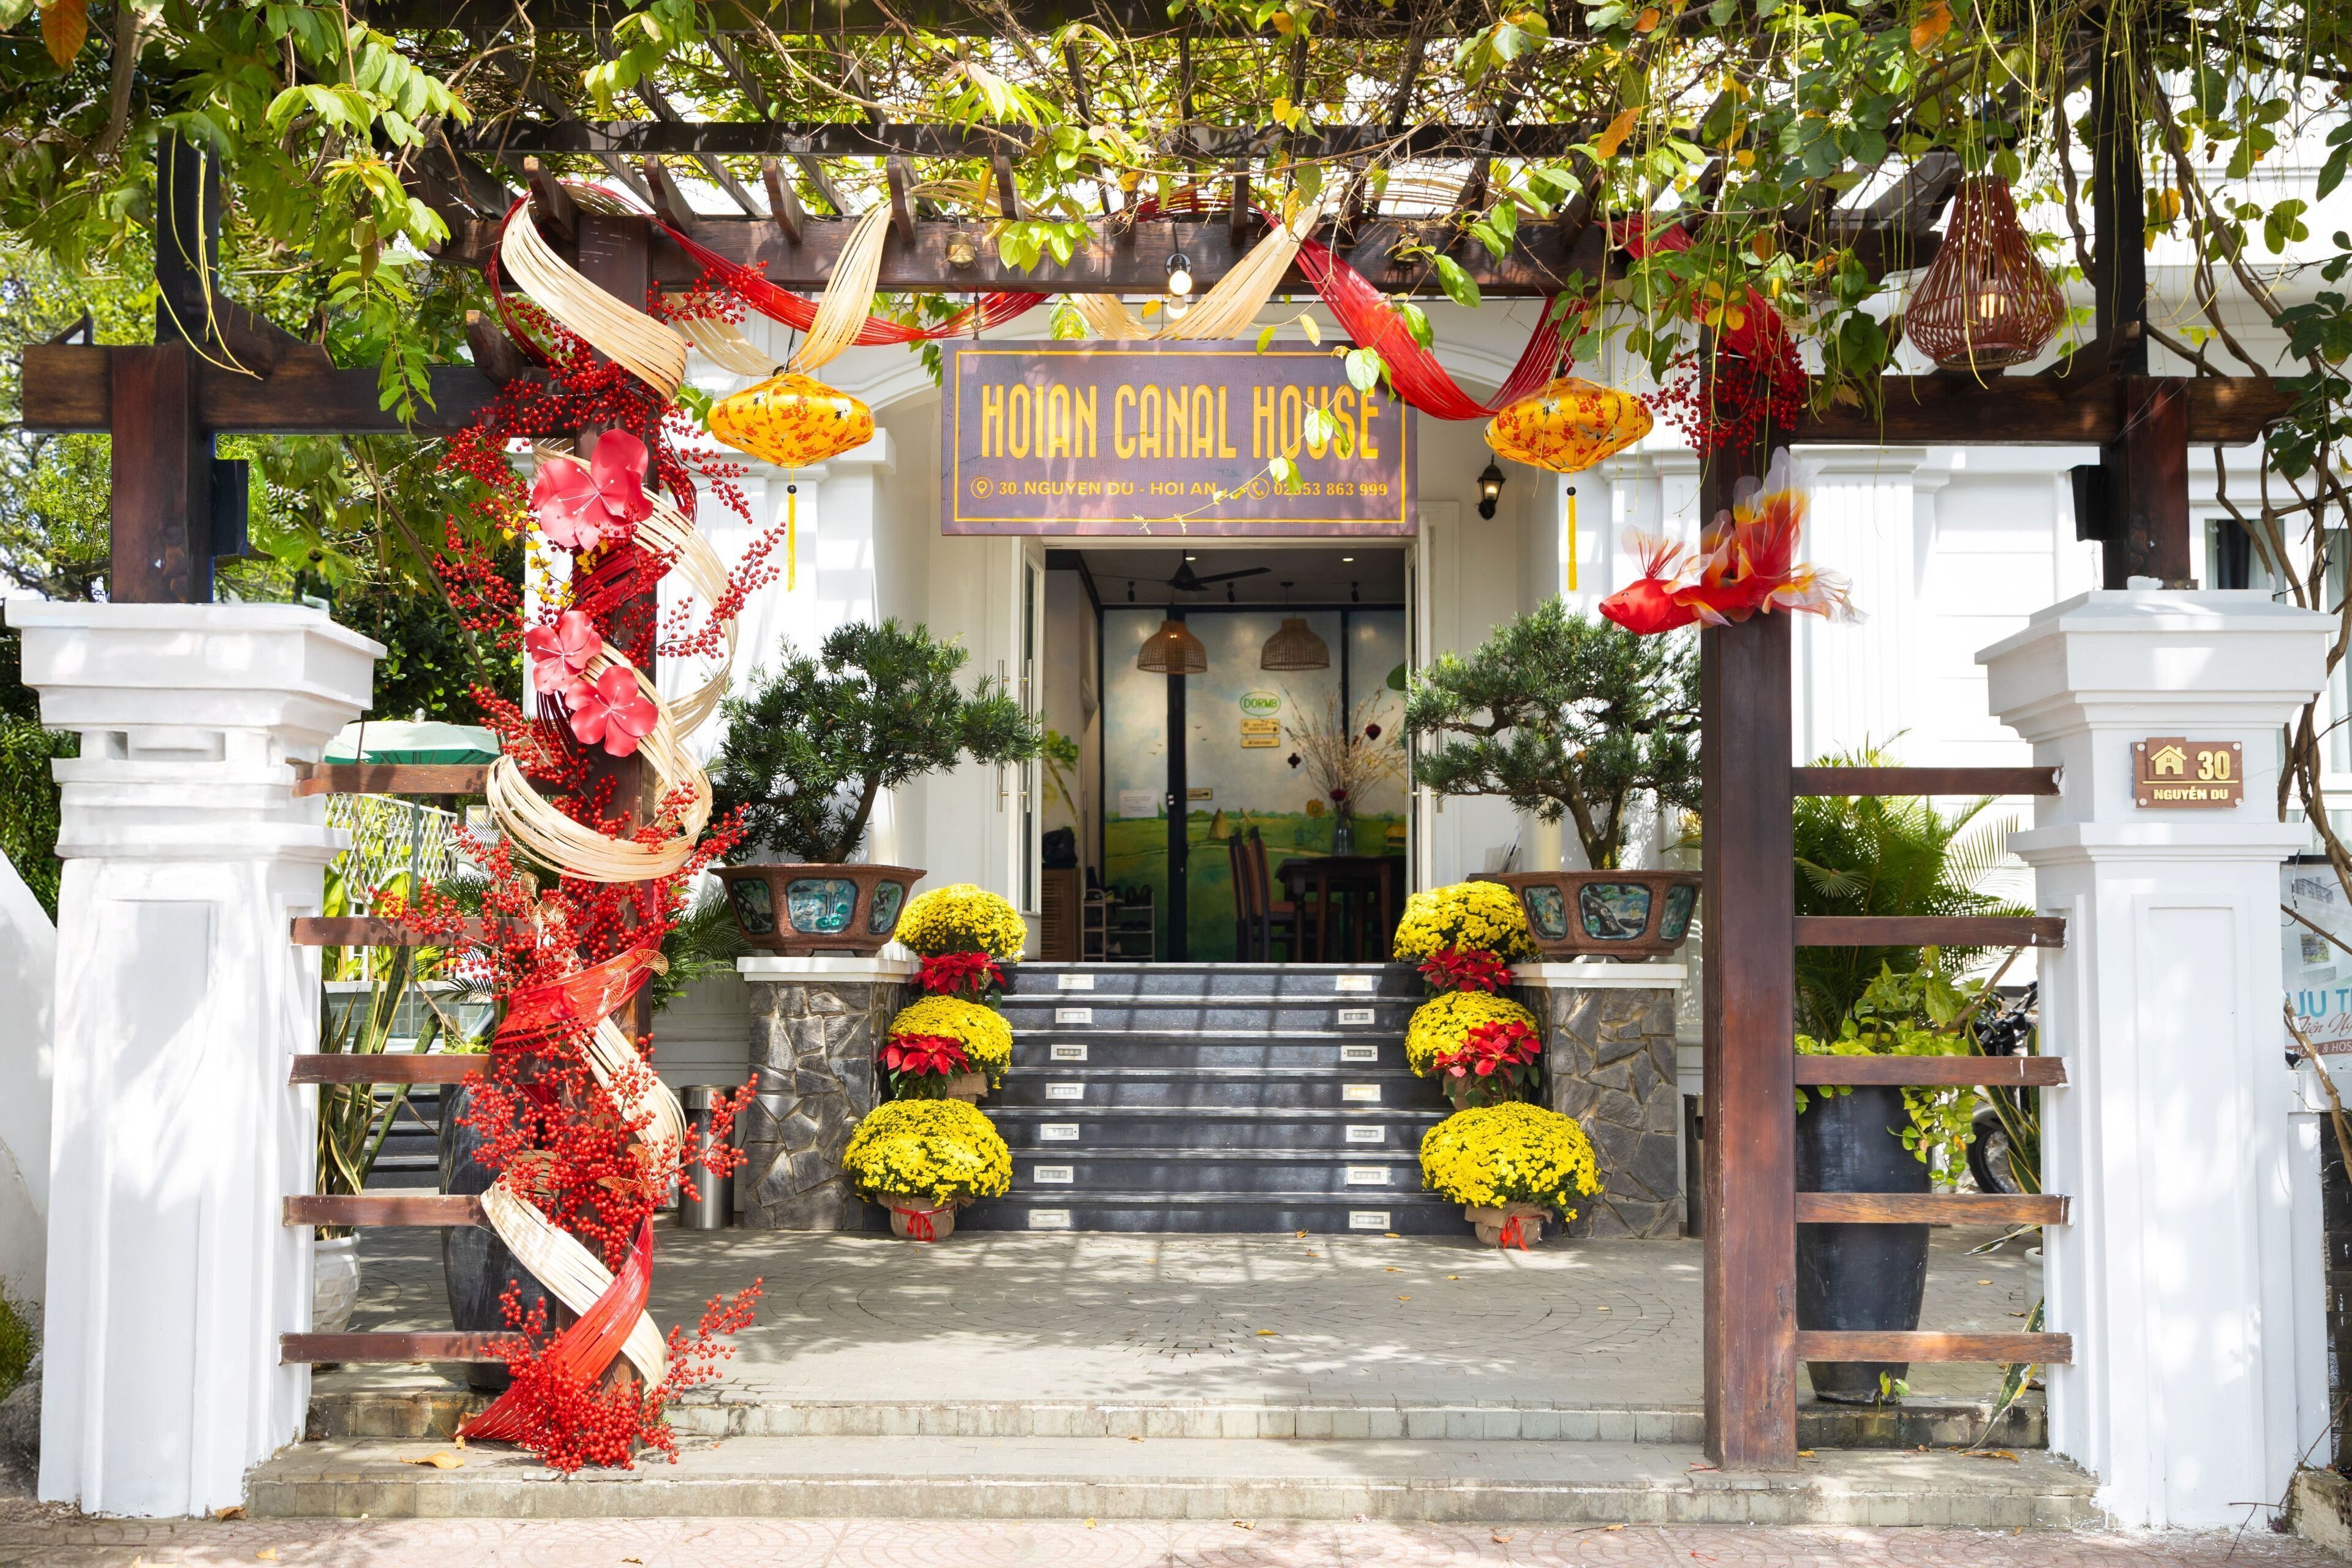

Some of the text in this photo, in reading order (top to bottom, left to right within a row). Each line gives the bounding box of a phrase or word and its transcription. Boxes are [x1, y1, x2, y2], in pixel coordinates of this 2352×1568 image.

[981, 383, 1379, 460] HOIAN CANAL HOUSE
[1024, 481, 1101, 495] NGUYEN
[1107, 481, 1134, 495] DU
[1150, 481, 1184, 495] HOI
[1190, 481, 1216, 495] AN
[1326, 483, 1354, 496] 863
[1359, 483, 1388, 496] 999
[2198, 750, 2231, 780] 30
[2211, 788, 2229, 799] DU
[2335, 988, 2352, 1012] T
[2293, 1045, 2320, 1057] HOL
[2322, 1044, 2329, 1053] &
